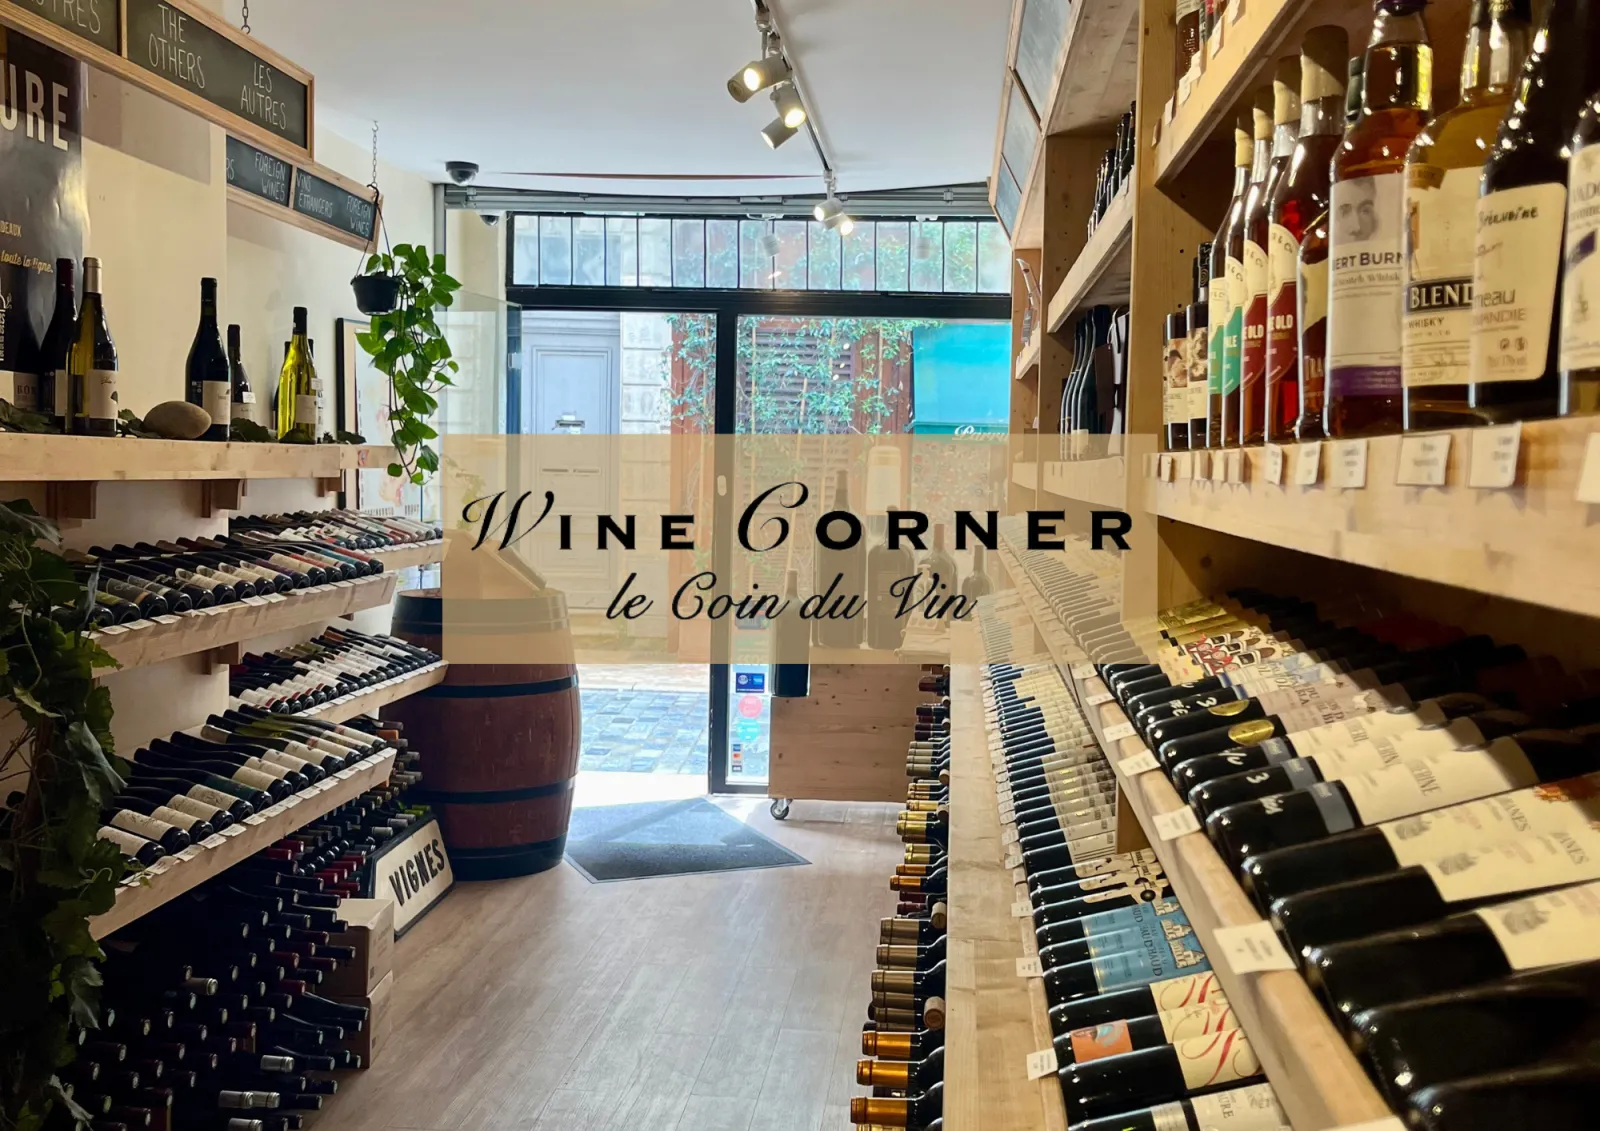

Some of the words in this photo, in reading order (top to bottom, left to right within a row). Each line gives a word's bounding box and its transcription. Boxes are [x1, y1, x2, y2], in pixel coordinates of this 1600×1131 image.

[158, 3, 187, 43] THE
[148, 33, 205, 89] OTHERS
[253, 61, 272, 93] LES
[240, 85, 286, 130] AUTRES
[255, 151, 286, 181] FOREIGN
[261, 179, 286, 202] WINES
[346, 195, 371, 218] FOREIGN
[350, 217, 371, 237] WINES
[1332, 255, 1357, 271] ERT
[1408, 316, 1445, 329] WHISKY
[389, 839, 445, 907] VIGNES
